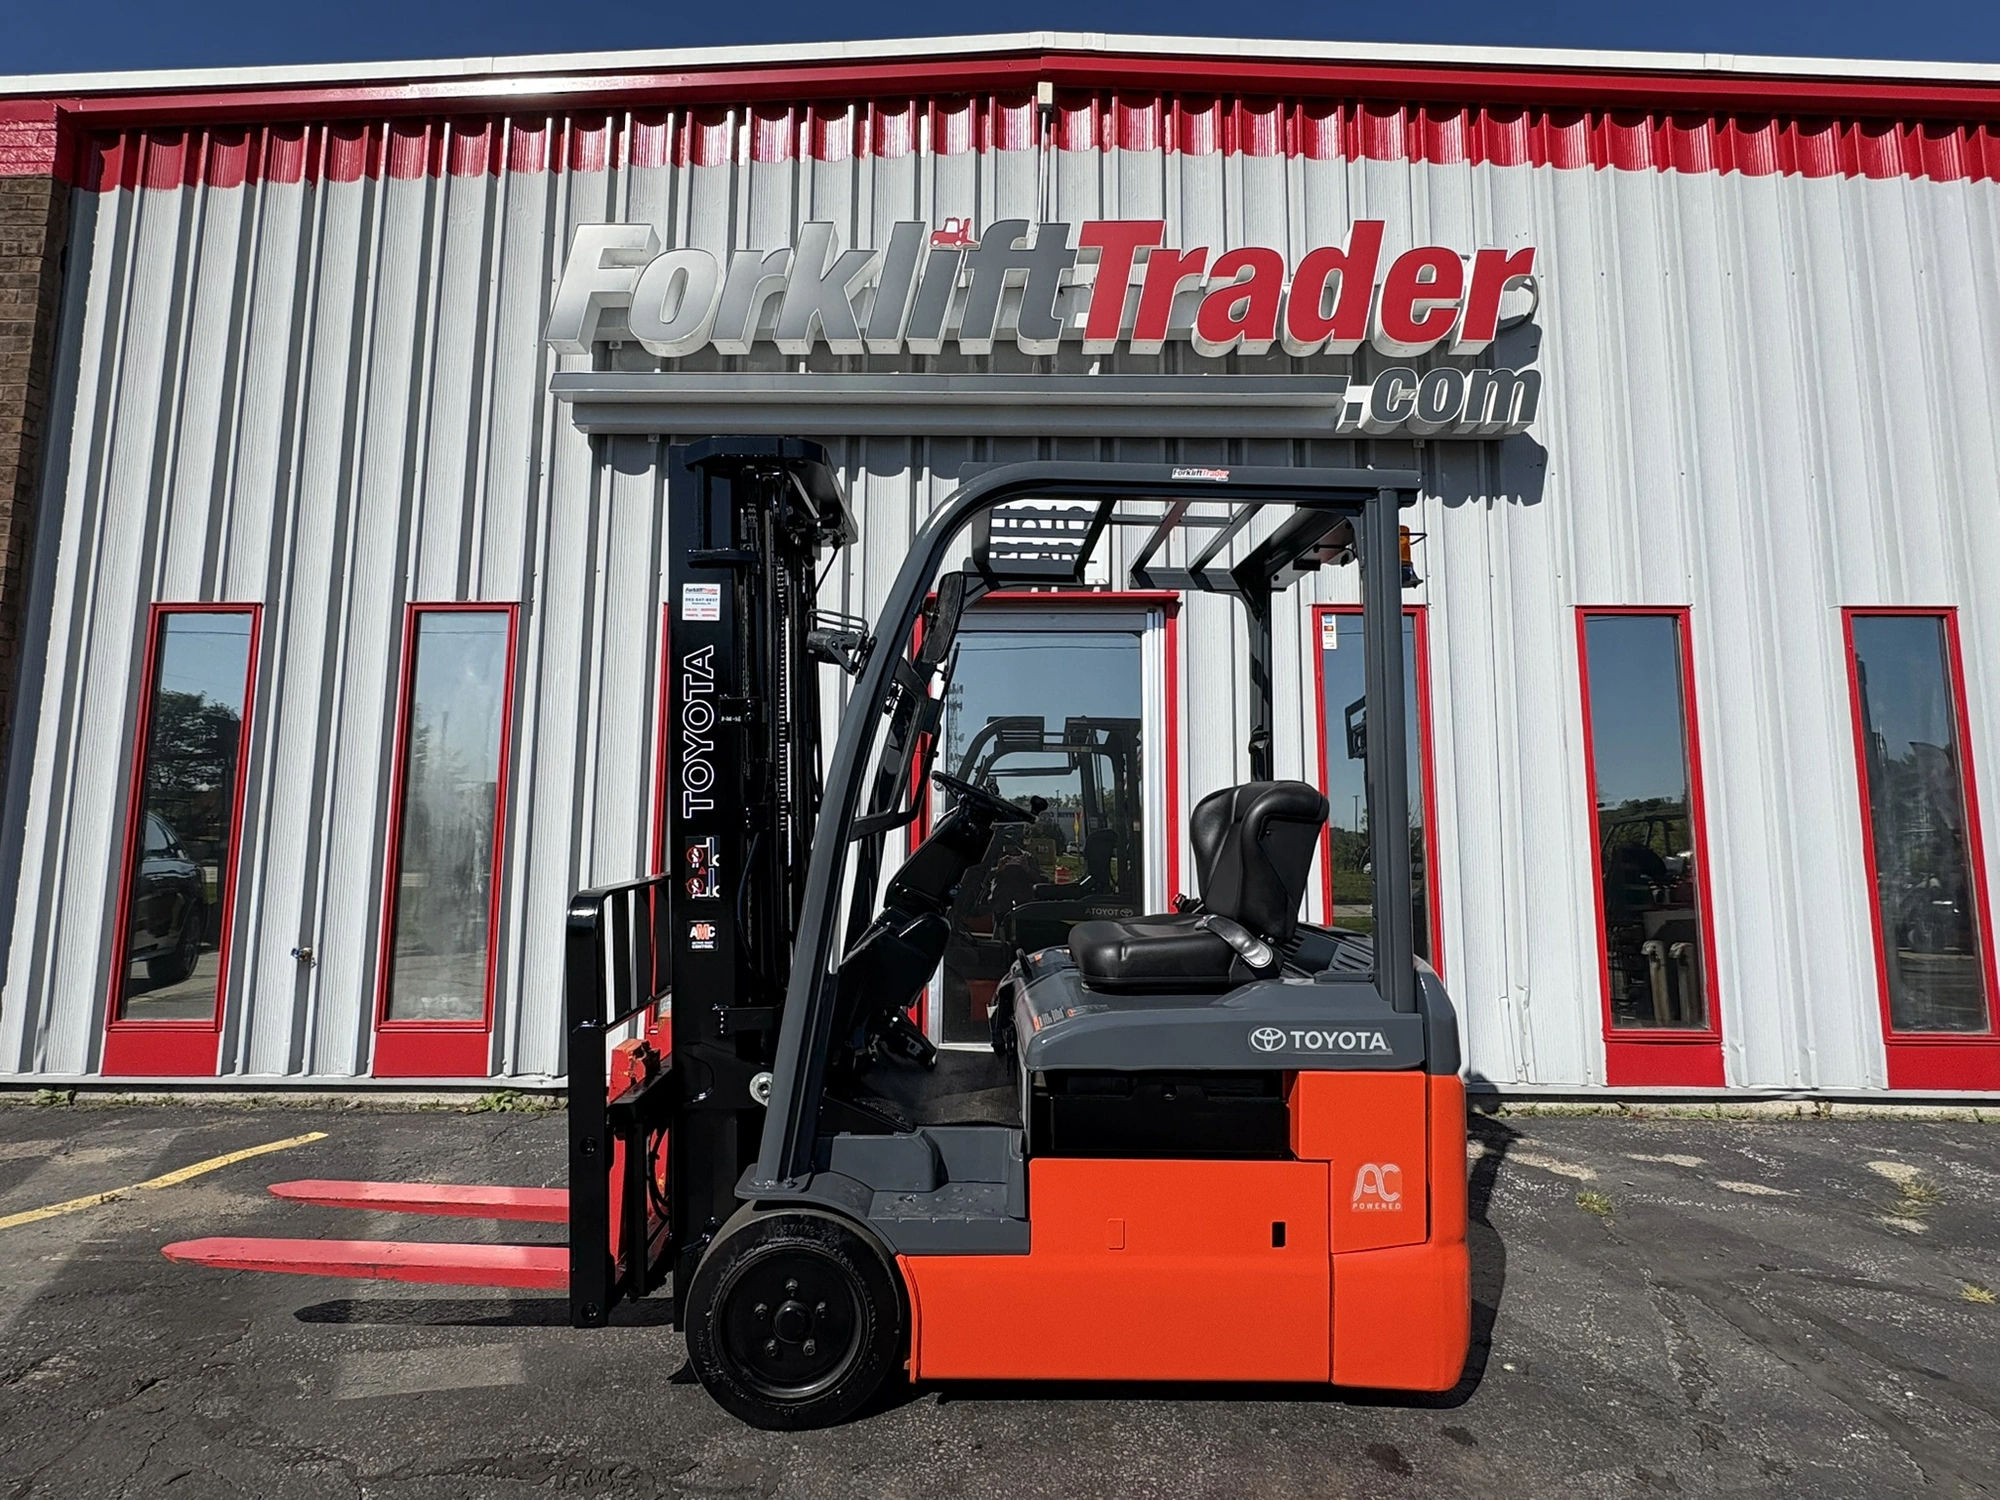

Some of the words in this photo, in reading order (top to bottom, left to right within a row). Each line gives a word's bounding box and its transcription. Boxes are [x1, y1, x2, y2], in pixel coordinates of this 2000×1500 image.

[544, 219, 1536, 352] ForkliftTrader
[1340, 366, 1542, 431] .com
[1173, 468, 1228, 477] ForkliftTrader
[683, 645, 714, 819] TOYOTA
[690, 924, 716, 940] AMC
[1290, 1031, 1386, 1050] TOYOTA
[1353, 1163, 1400, 1202] AC
[1352, 1202, 1401, 1210] POWERED
